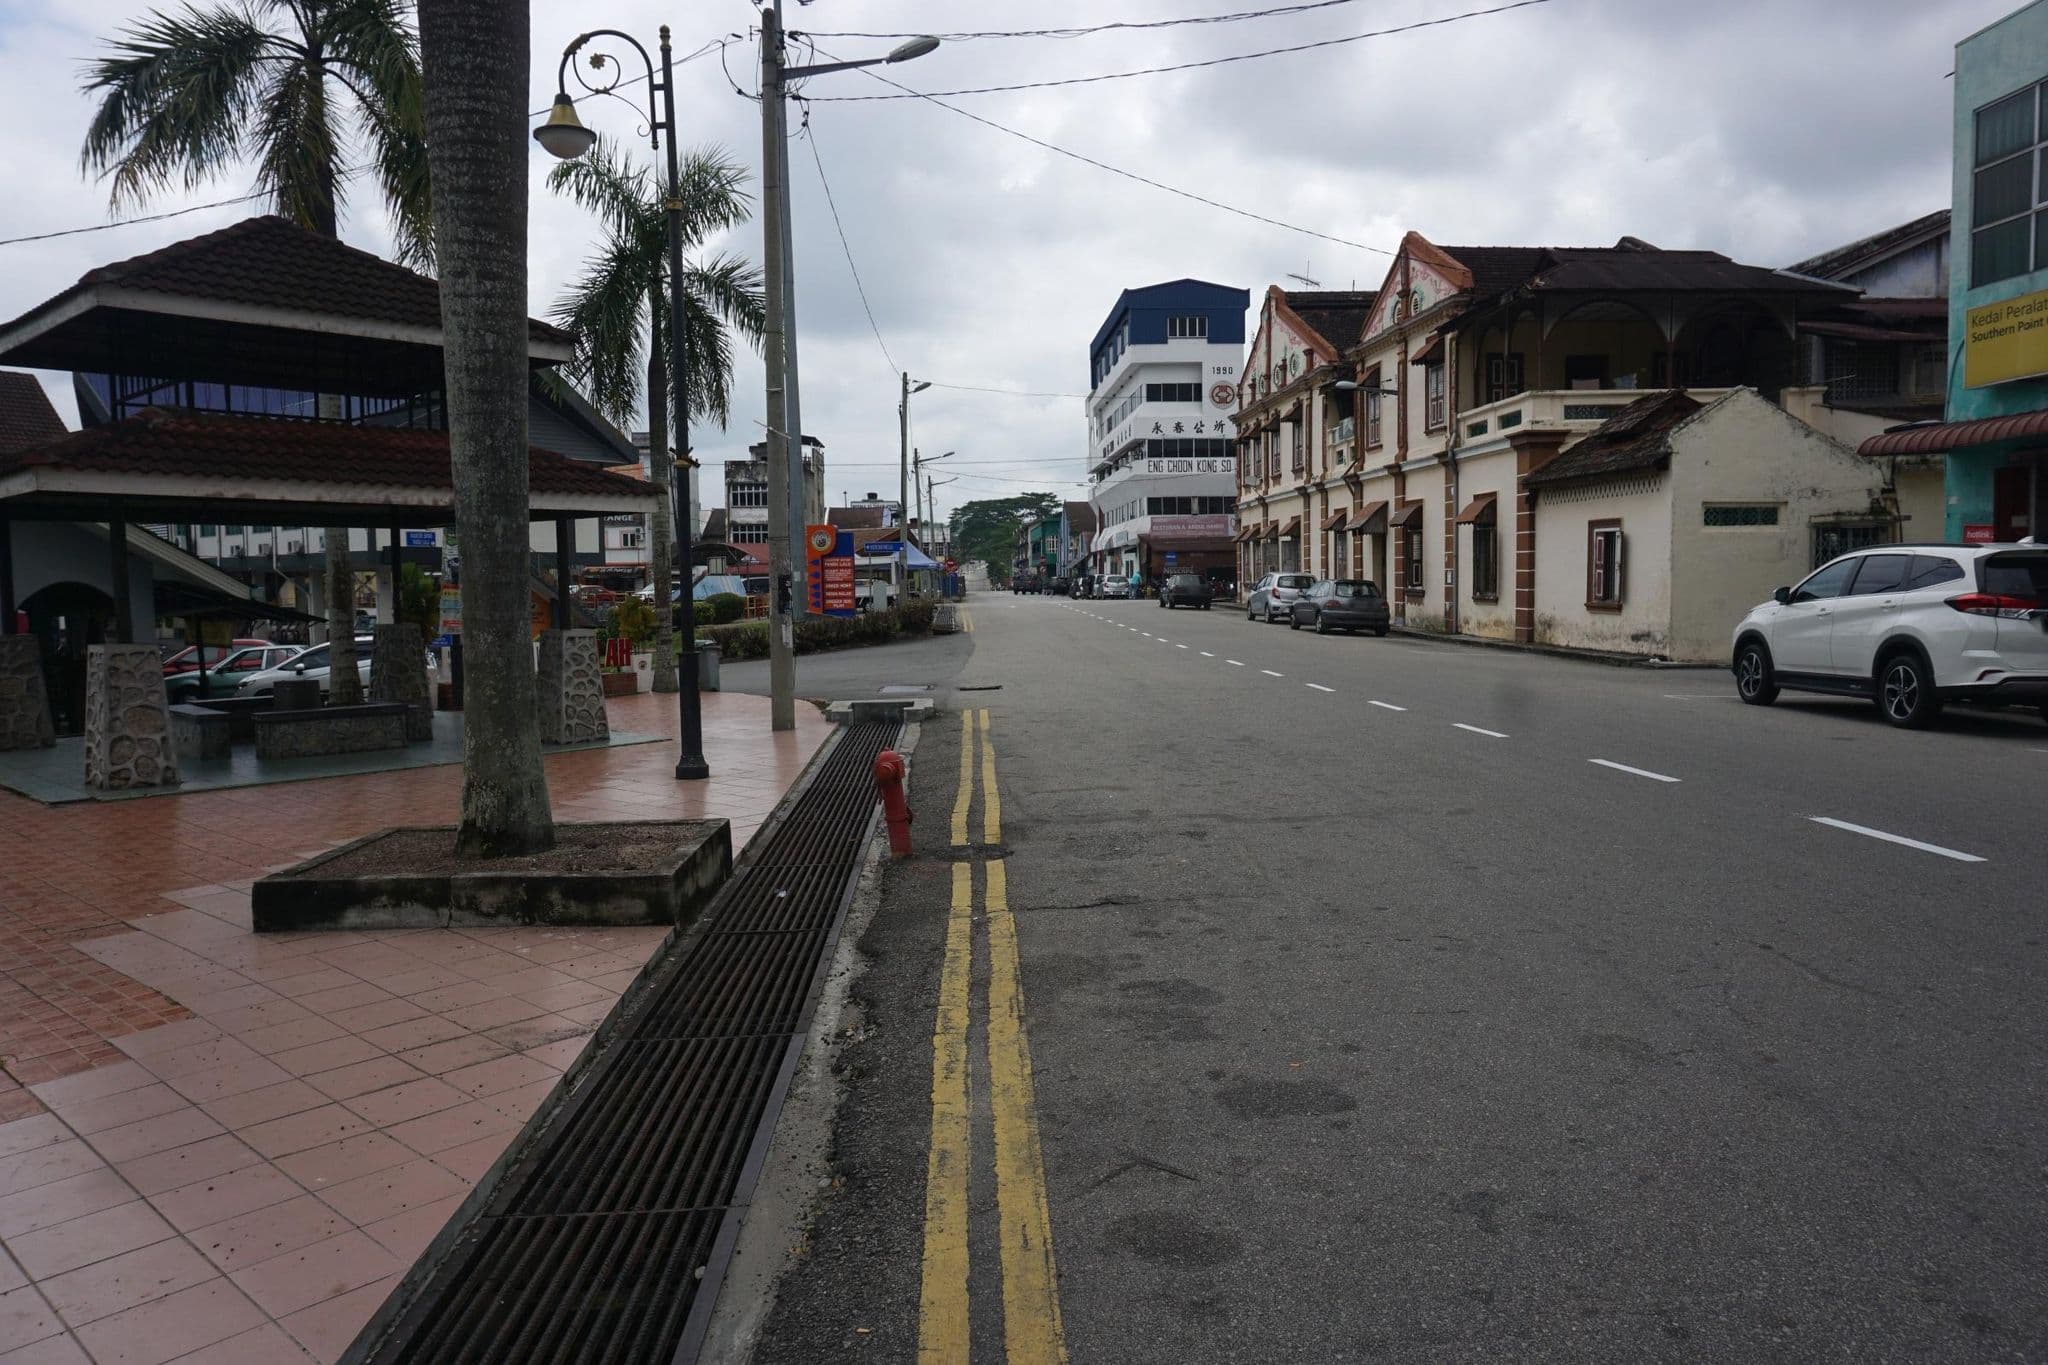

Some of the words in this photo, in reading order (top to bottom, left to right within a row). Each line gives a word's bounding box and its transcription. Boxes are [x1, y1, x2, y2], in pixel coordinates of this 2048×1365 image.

[1972, 309, 2003, 328] Kedai
[1972, 325, 2015, 343] Southern
[2018, 317, 2044, 332] Point
[1212, 366, 1233, 375] 1990
[1151, 419, 1226, 434] 永春公所
[1148, 460, 1164, 473] ENG
[1167, 460, 1193, 473] CHOON
[1197, 460, 1217, 472] KONG
[1221, 459, 1232, 472] SO
